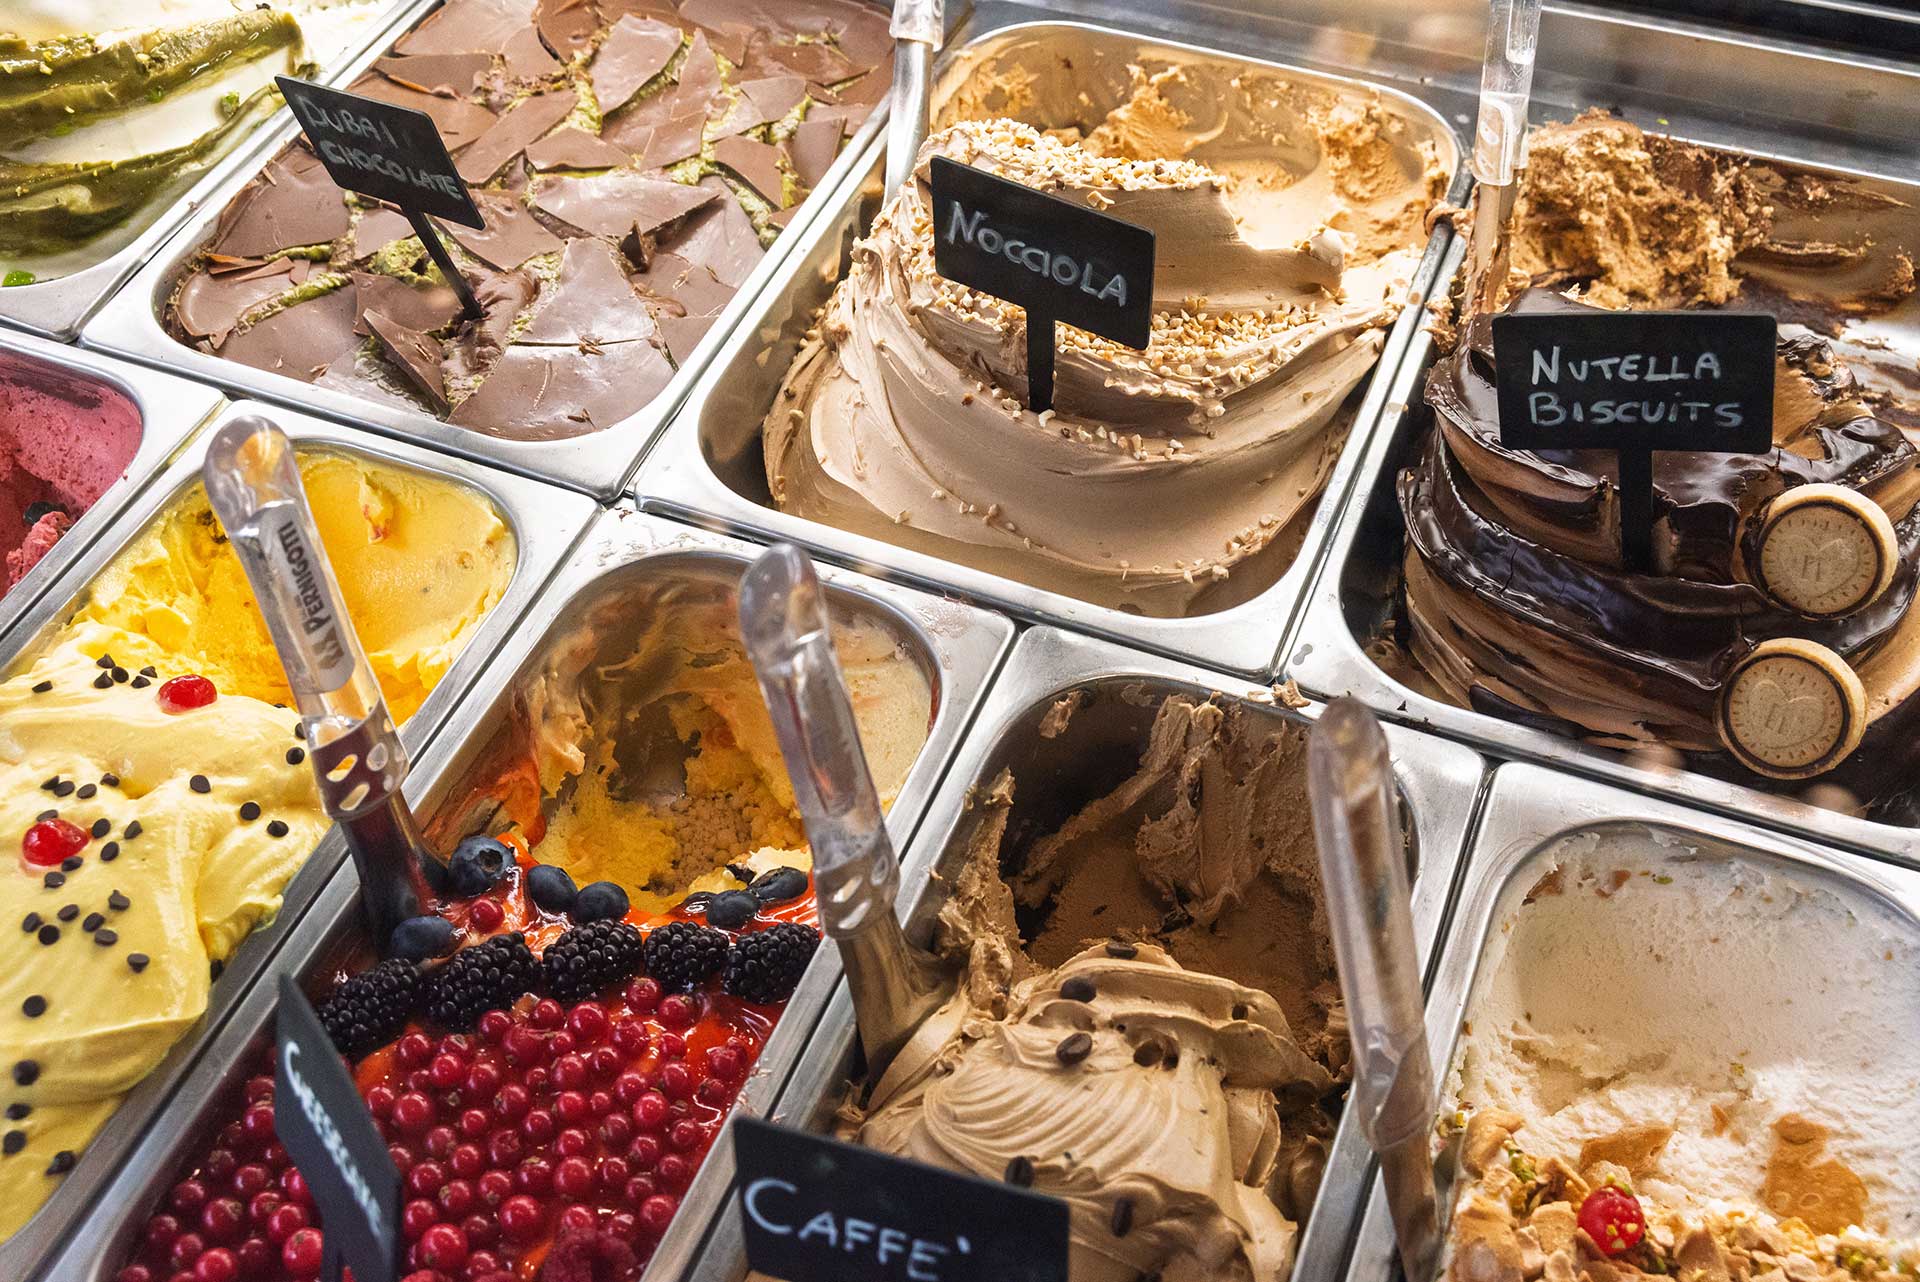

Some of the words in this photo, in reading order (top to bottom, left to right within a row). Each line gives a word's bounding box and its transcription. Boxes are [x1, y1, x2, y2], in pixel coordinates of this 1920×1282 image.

[295, 93, 400, 149] DUBAI
[319, 139, 464, 201] CHOCOLATE
[944, 200, 1128, 308] NOCCIOLA
[1531, 345, 1722, 386] NUTELLA
[276, 520, 333, 636] PERNIGOTTI
